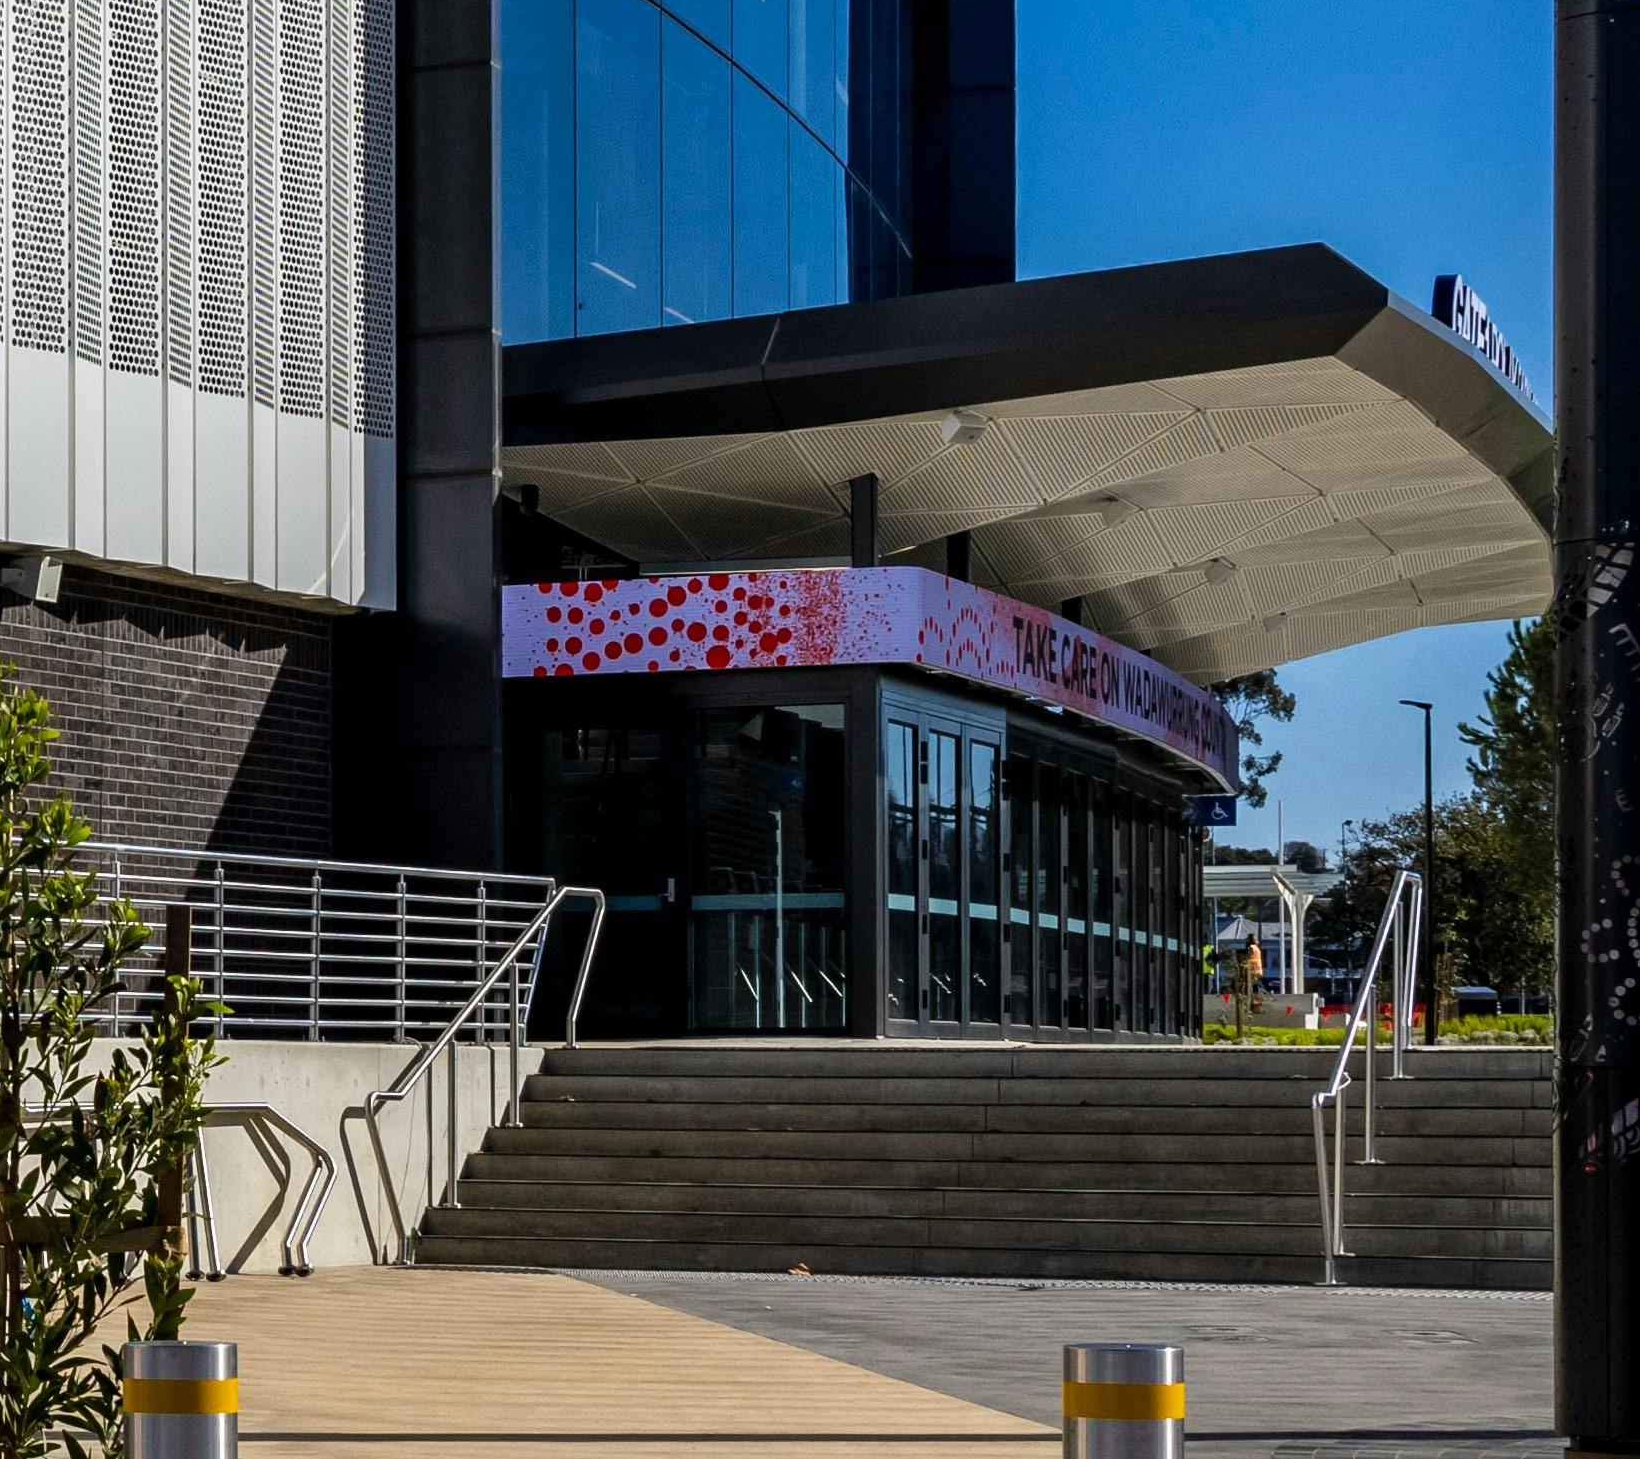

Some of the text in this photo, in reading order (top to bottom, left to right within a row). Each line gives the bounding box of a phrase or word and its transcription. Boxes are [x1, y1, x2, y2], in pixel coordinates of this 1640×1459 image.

[1013, 615, 1058, 685] TAKE
[1061, 634, 1098, 700] CARE
[1100, 650, 1120, 709] ON
